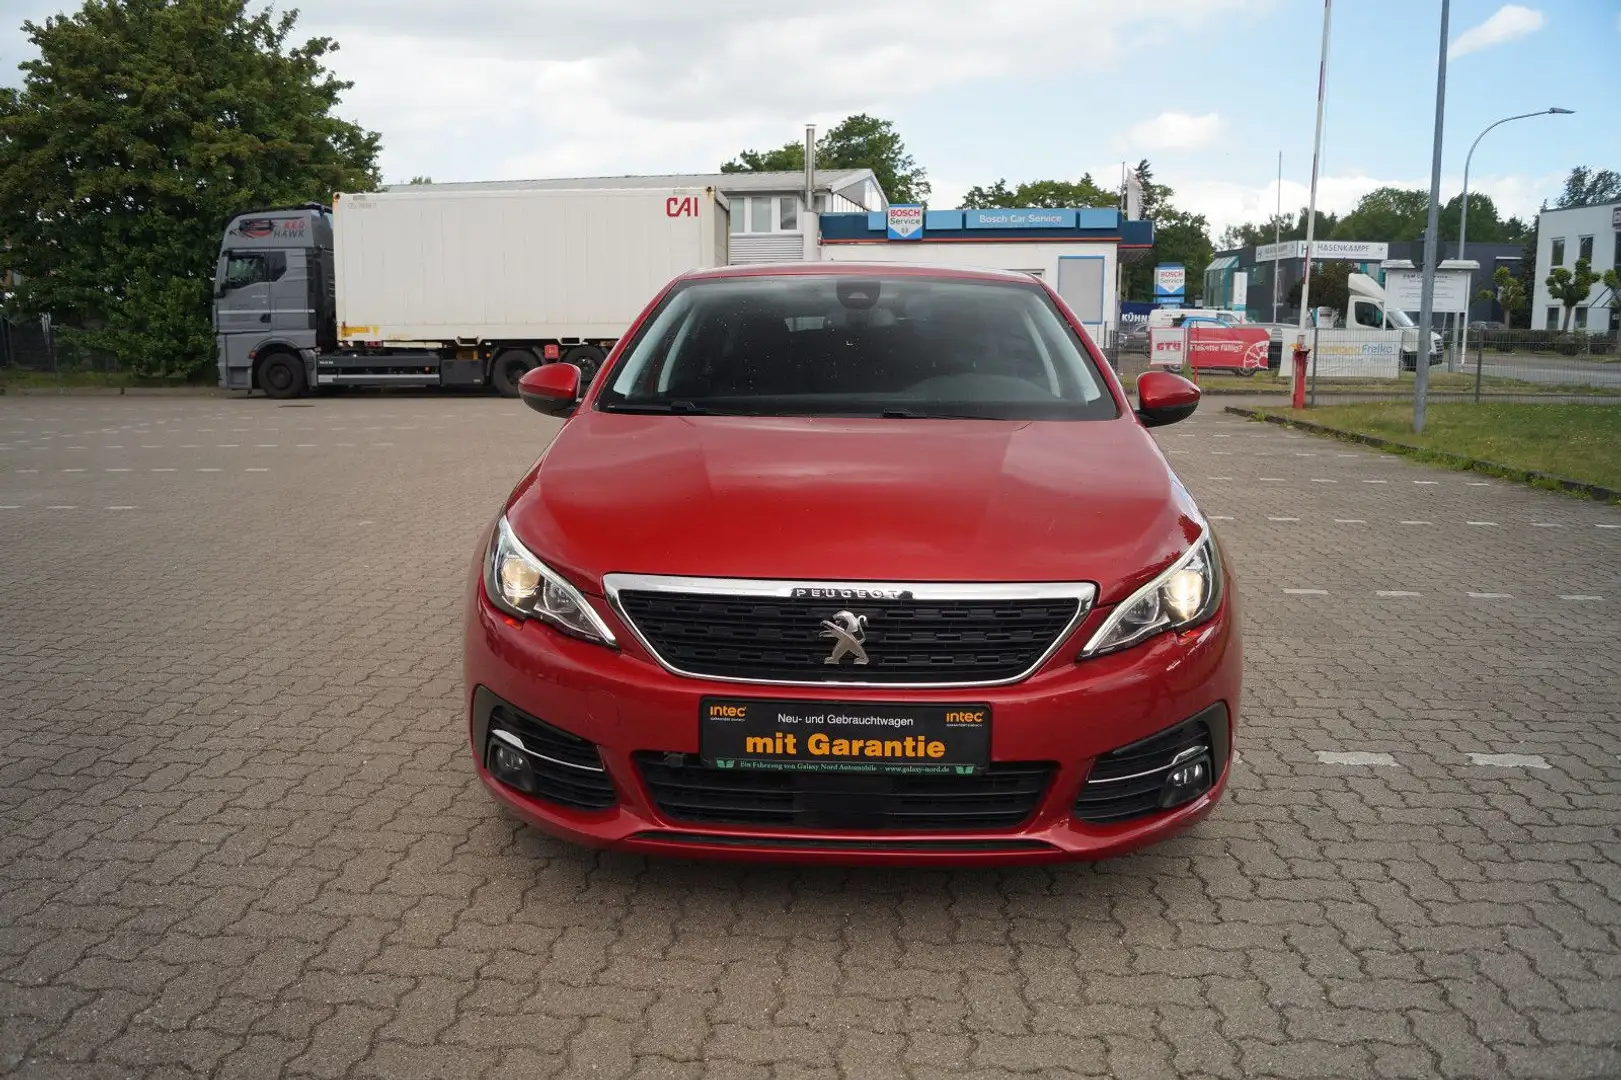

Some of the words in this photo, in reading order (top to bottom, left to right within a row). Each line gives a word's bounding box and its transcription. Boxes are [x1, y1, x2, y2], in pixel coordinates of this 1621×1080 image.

[666, 197, 698, 217] CAI
[890, 209, 920, 217] BOSCH
[980, 214, 1008, 223] Bosch
[1010, 214, 1026, 223] Car
[1028, 213, 1062, 223] Service
[890, 217, 920, 225] Service
[273, 230, 305, 238] HAWK
[1317, 243, 1369, 252] HASENKAMPF
[796, 588, 898, 598] PEUGEOT
[710, 705, 746, 717] intec
[777, 713, 802, 723] Neu-
[805, 714, 824, 724] und
[827, 714, 914, 728] Gebrauchtwagen
[946, 711, 984, 723] intec
[746, 732, 797, 754] mit
[807, 733, 946, 758] Garantie
[797, 763, 819, 771] Galaxy
[838, 764, 877, 772] Automobile
[885, 765, 949, 774] www.galaxy-nord.de
